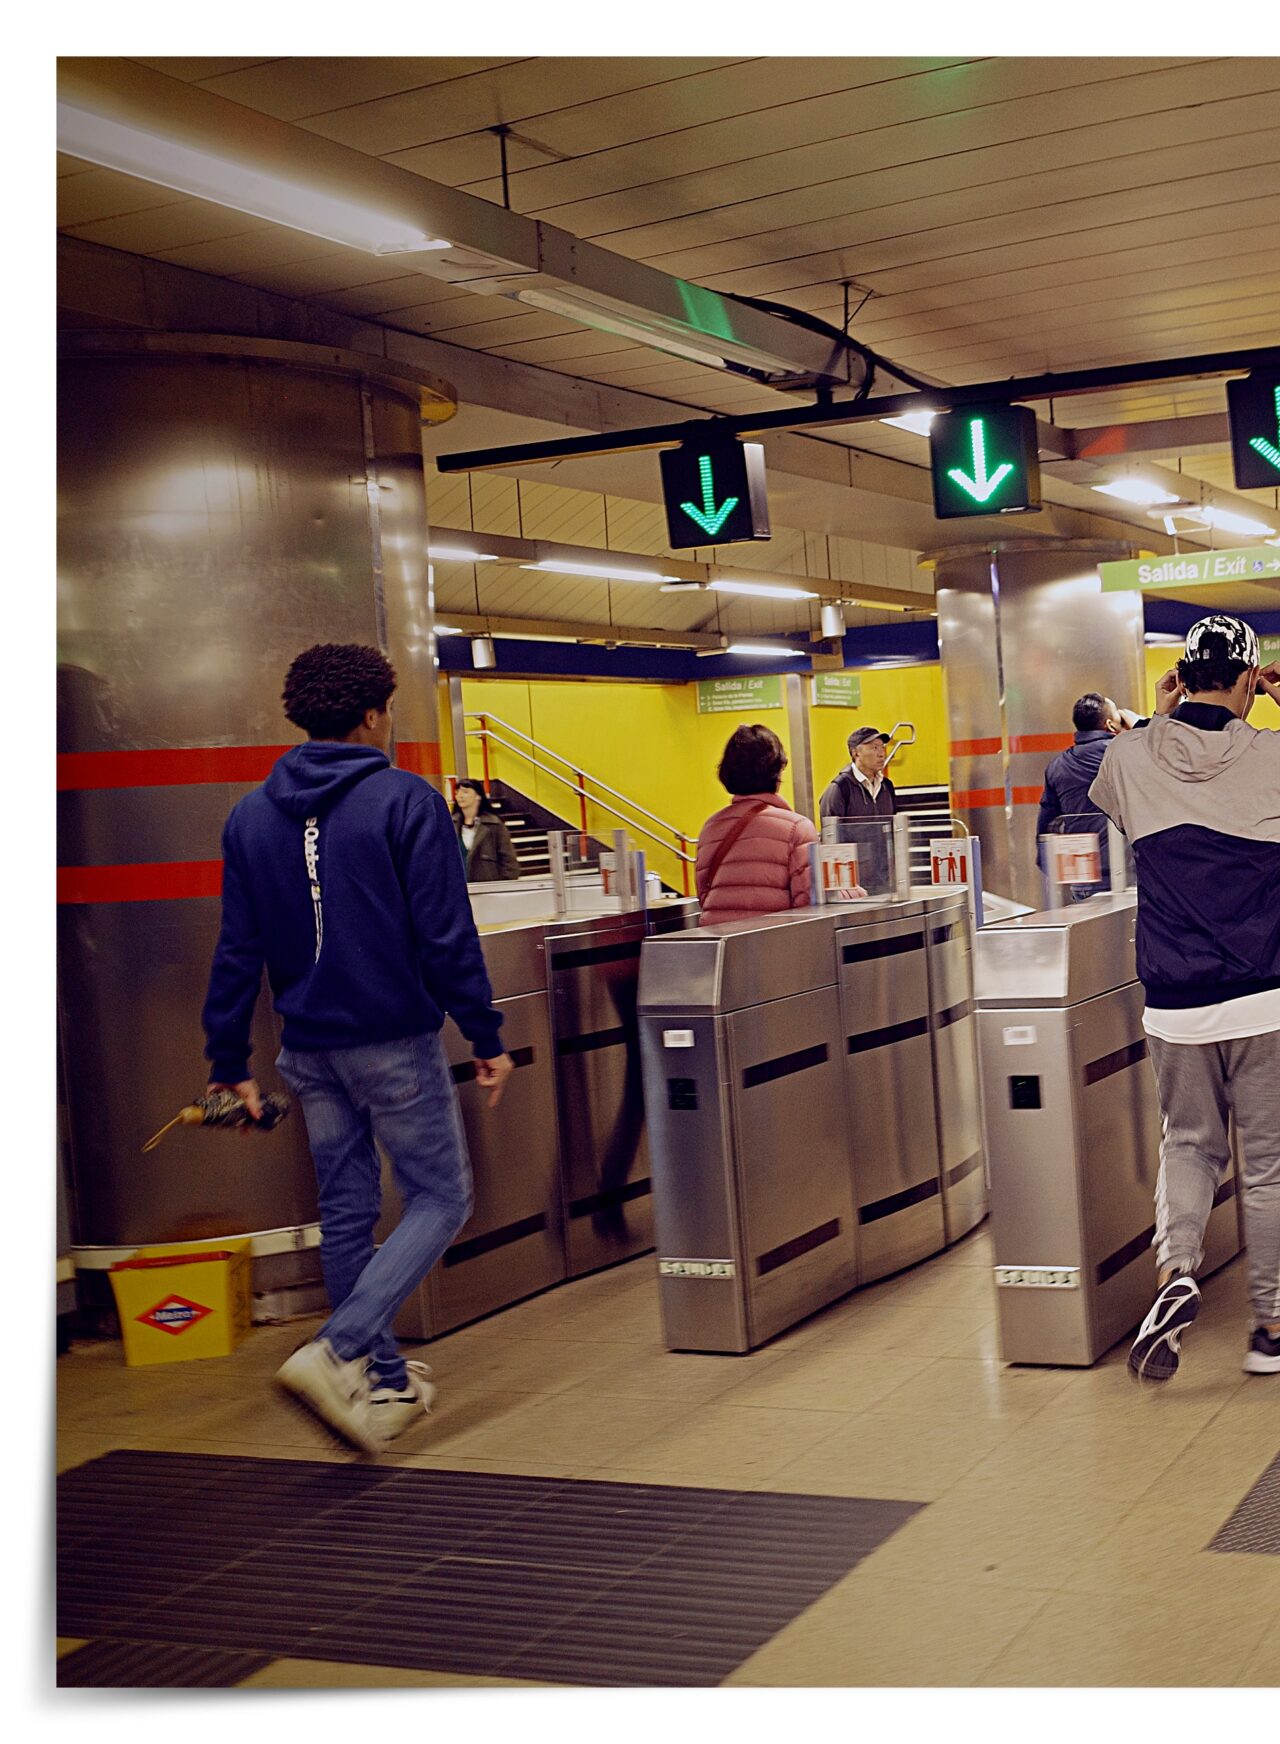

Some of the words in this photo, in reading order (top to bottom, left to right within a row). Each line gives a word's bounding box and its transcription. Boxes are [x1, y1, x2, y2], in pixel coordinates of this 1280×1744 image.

[1138, 560, 1199, 584] Salida
[1214, 555, 1247, 577] Exit
[715, 680, 742, 692] Salida
